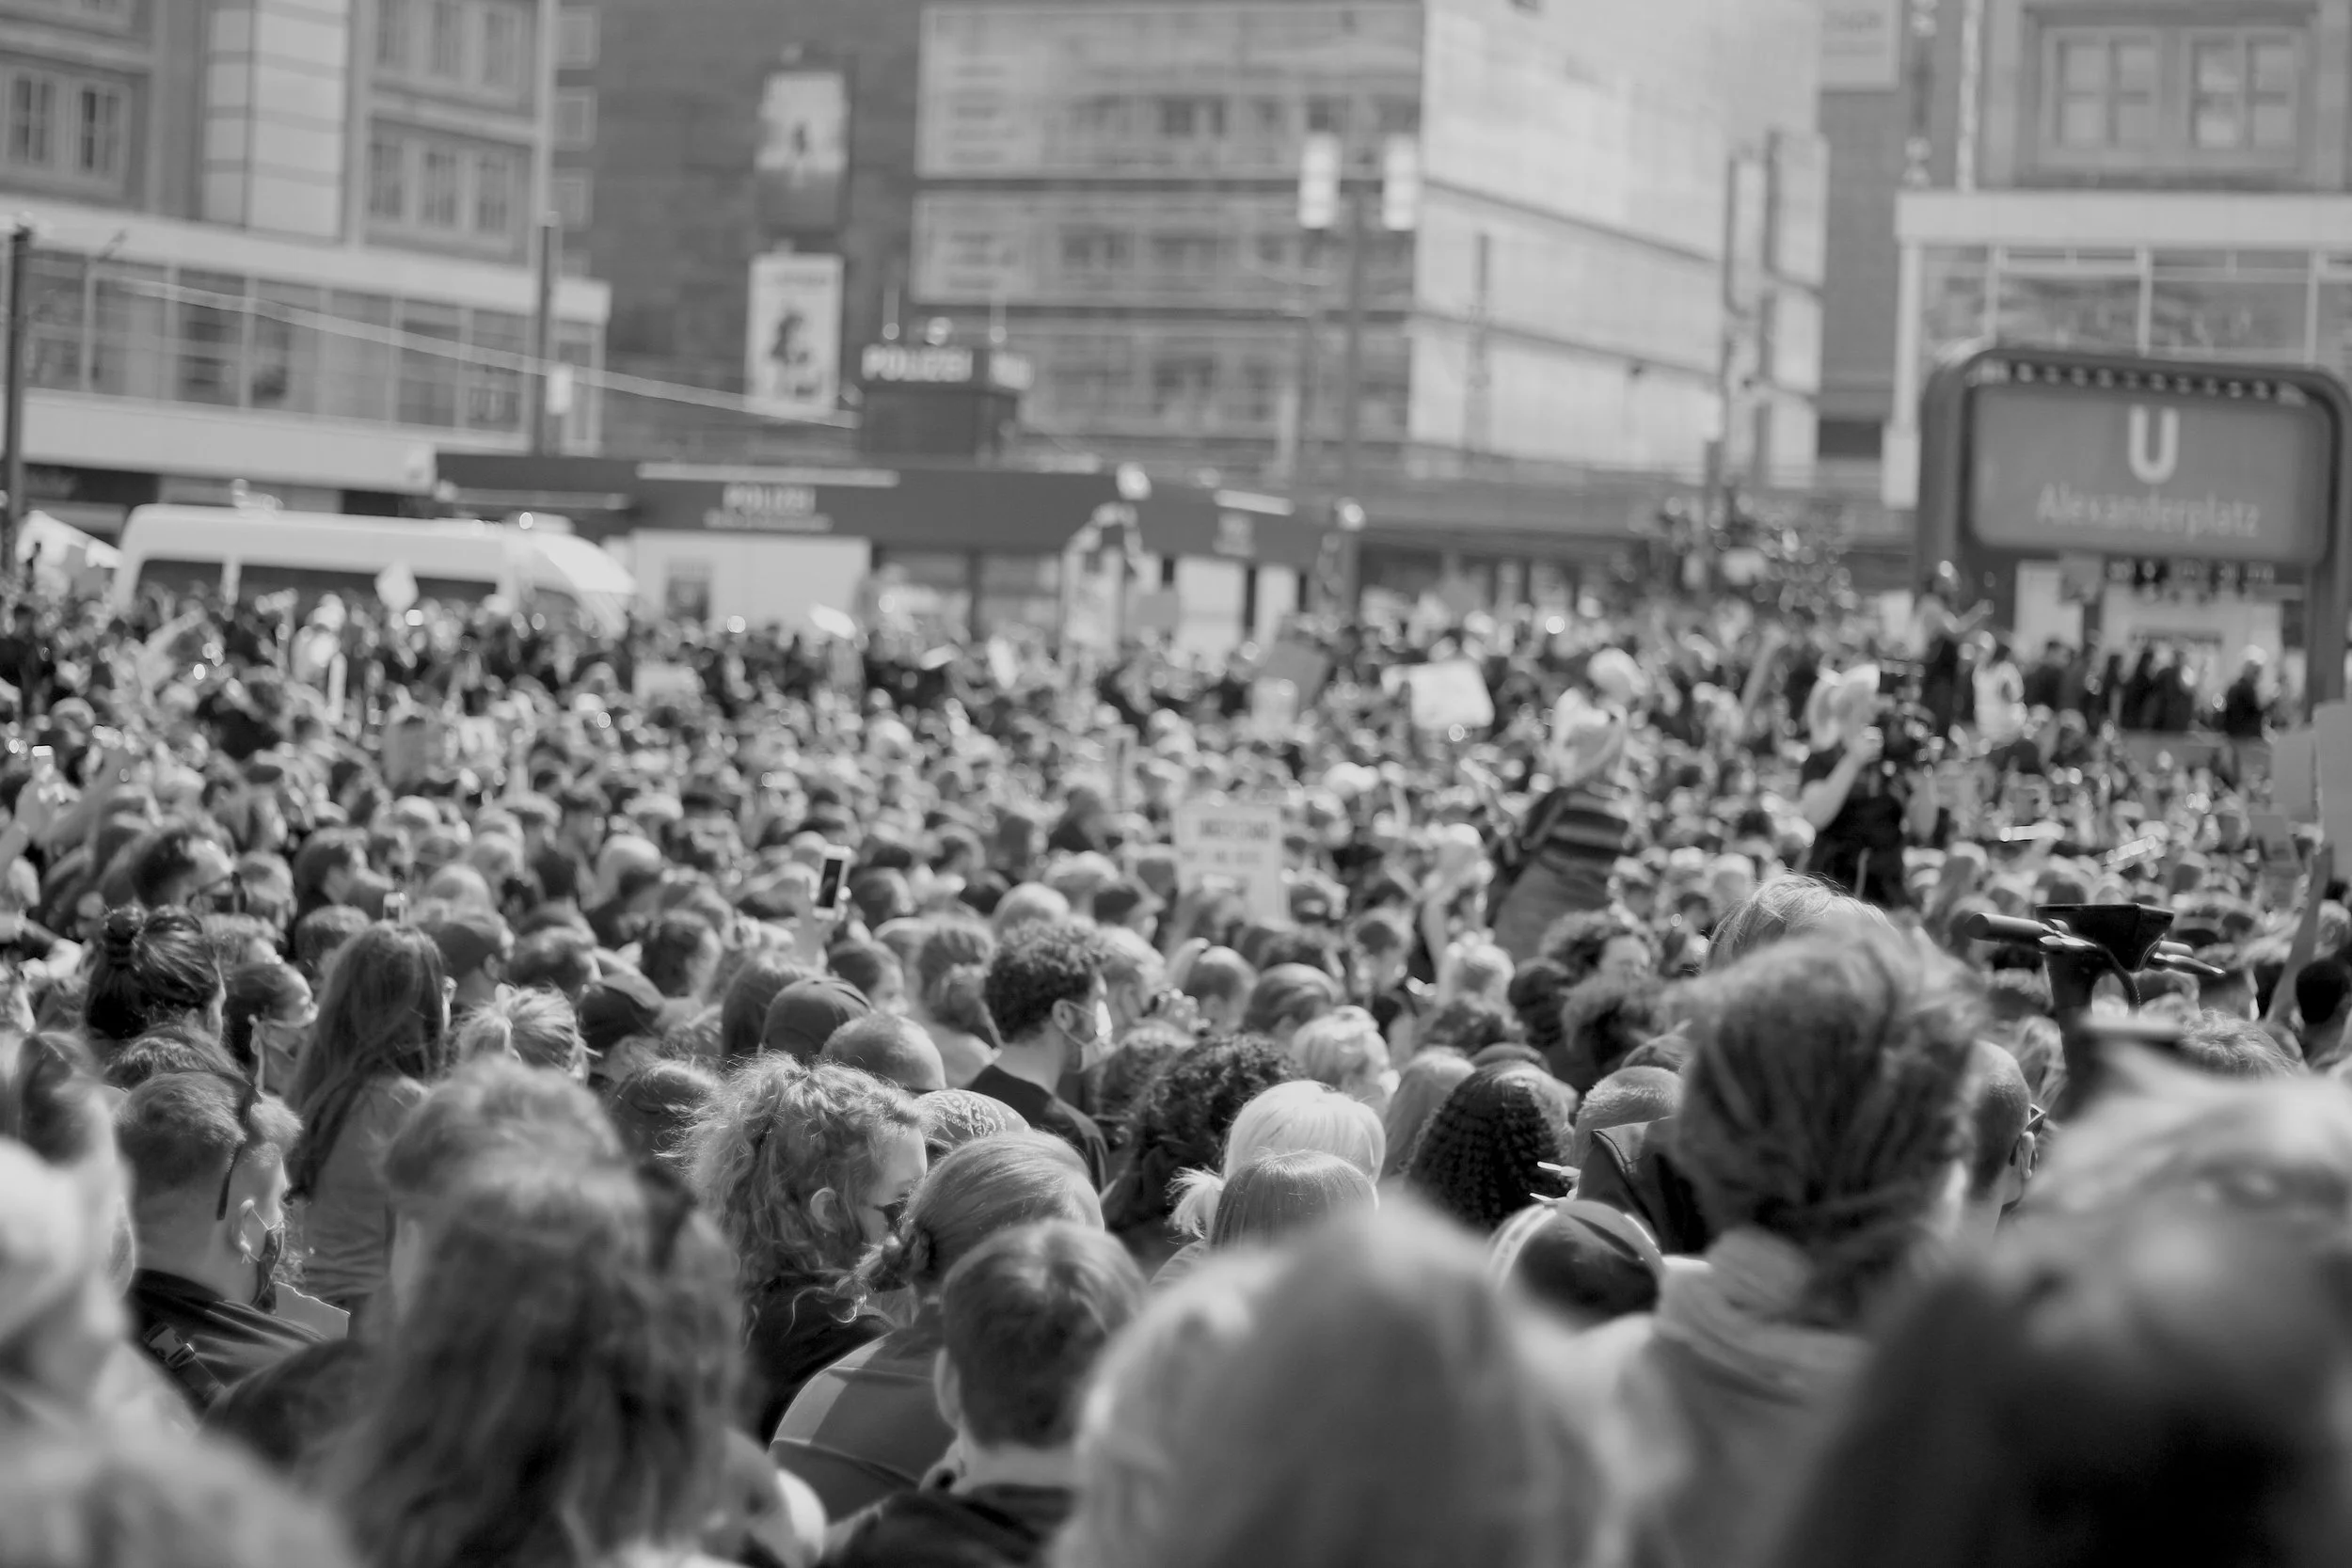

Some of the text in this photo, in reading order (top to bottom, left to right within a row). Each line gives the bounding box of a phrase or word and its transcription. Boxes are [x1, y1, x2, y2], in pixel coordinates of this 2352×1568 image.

[862, 345, 974, 382] POLIZEI
[2128, 404, 2179, 484] U
[2036, 482, 2261, 541] Alexanderplatz
